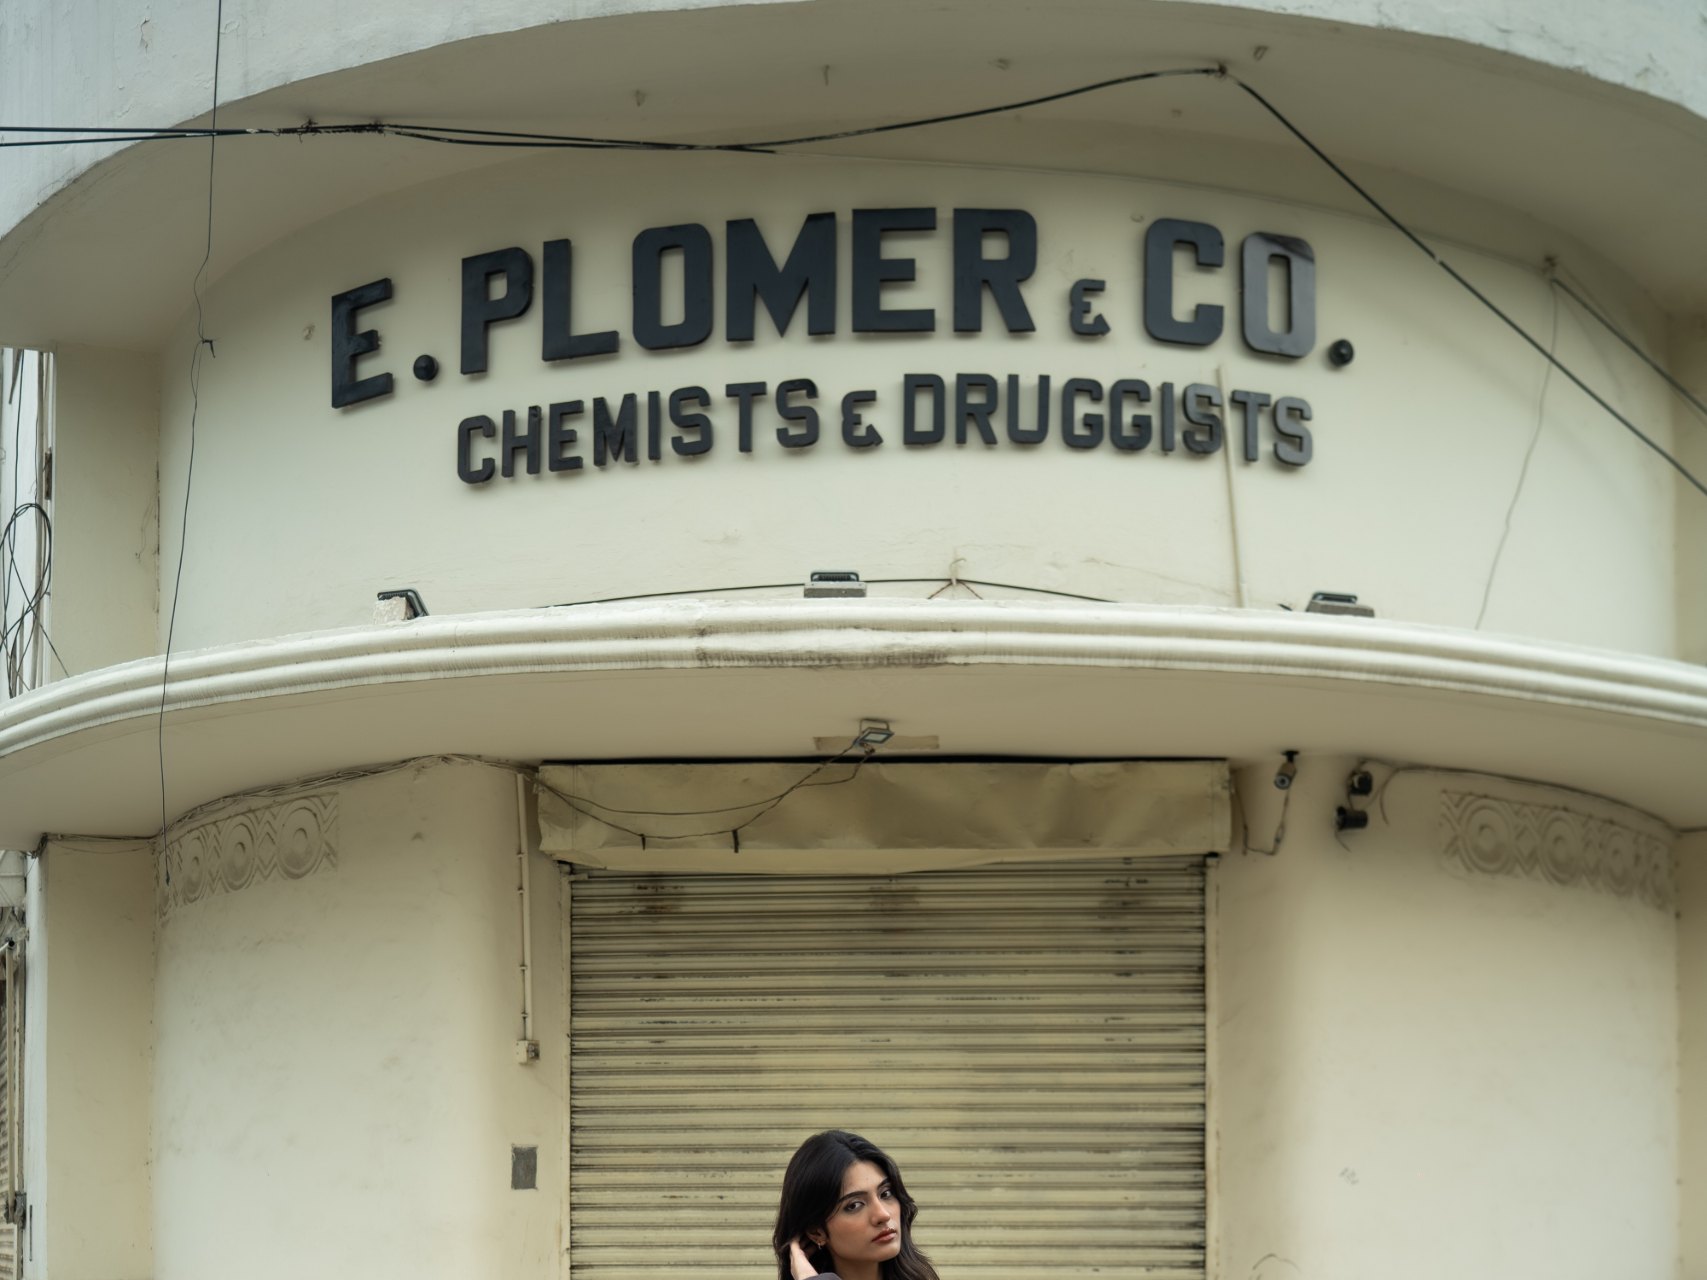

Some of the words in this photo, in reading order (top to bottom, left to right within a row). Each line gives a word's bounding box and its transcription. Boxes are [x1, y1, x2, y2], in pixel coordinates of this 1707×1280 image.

[331, 277, 439, 409] E.
[460, 207, 1038, 375] PLOMER
[1069, 278, 1112, 337] &
[1143, 217, 1355, 369] CO.
[456, 377, 821, 485] CHEMISTS
[840, 389, 884, 448] &
[903, 373, 1314, 467] DRUGGISTS
